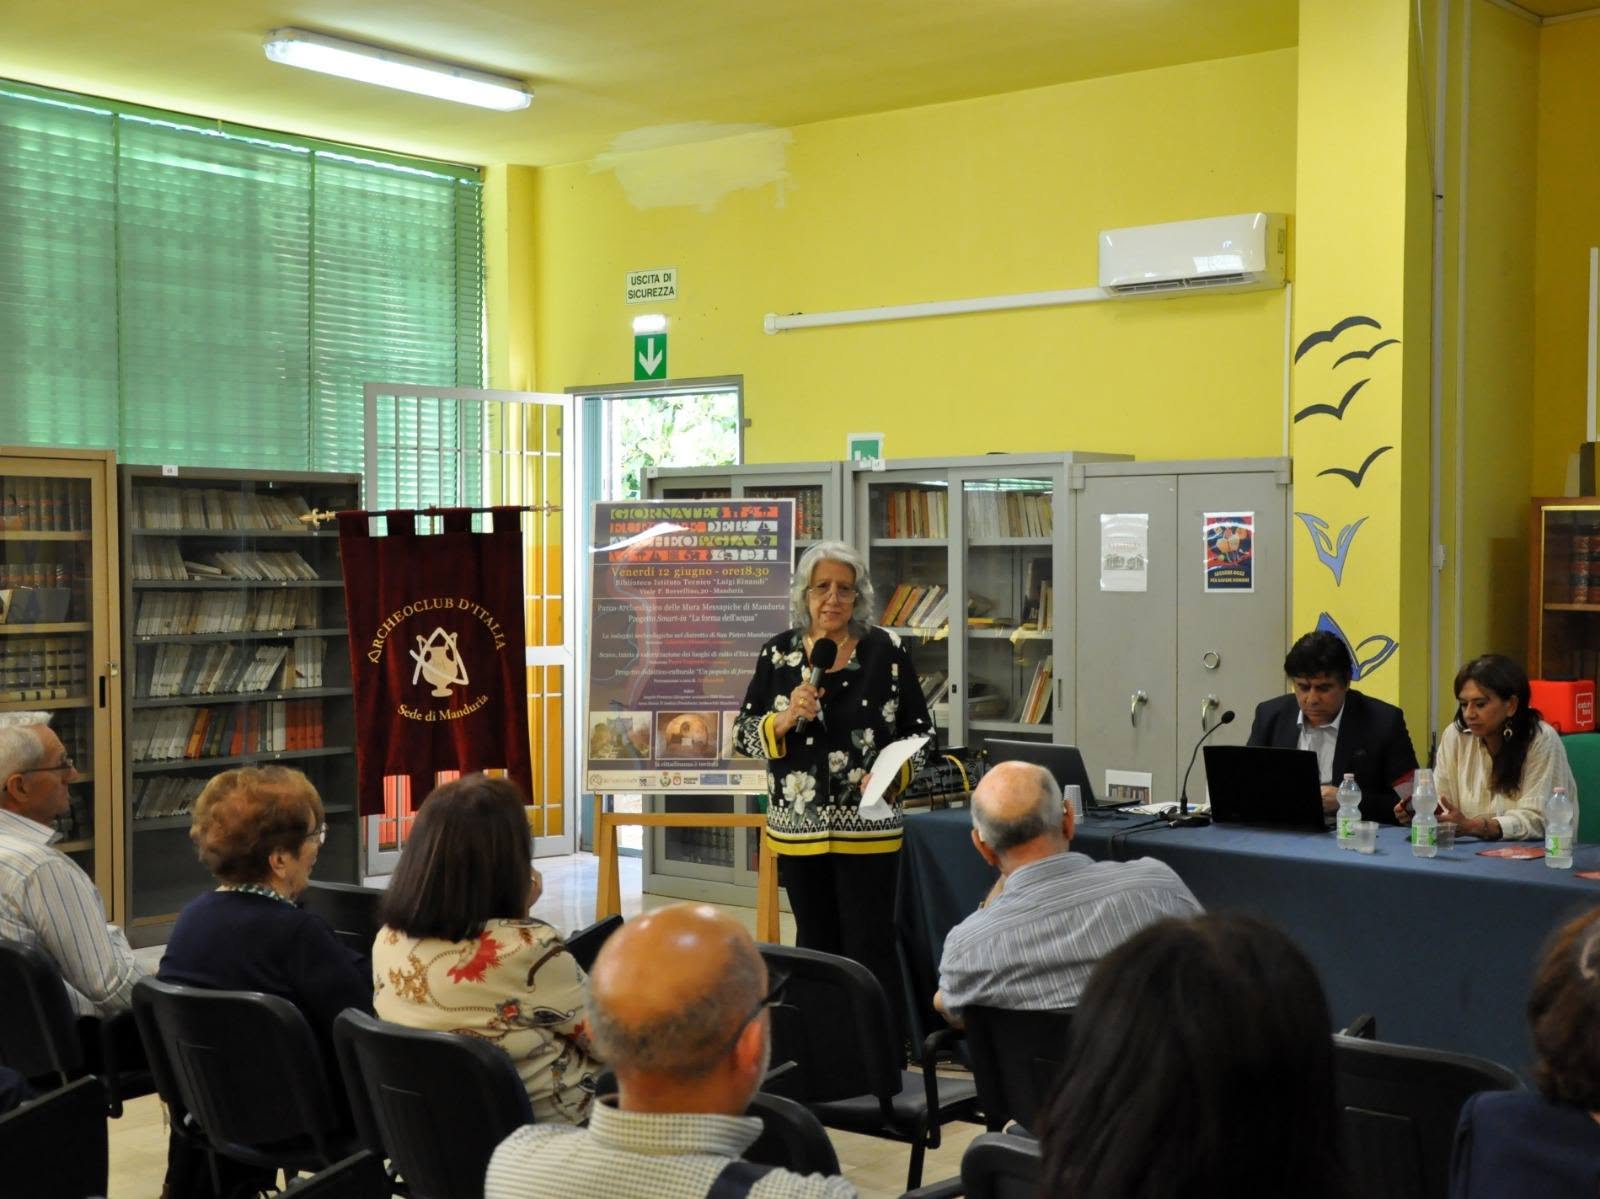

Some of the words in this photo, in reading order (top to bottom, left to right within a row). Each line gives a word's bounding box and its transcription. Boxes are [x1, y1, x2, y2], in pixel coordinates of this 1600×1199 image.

[631, 274, 660, 286] USCITA
[663, 272, 672, 283] DI
[627, 286, 675, 300] SICUREZZA
[659, 567, 670, 577] 12
[674, 566, 713, 579] giugno
[743, 602, 750, 611] di
[752, 602, 785, 611] Manduria
[367, 597, 454, 664] ARCHEOCLUB
[458, 597, 506, 651] D'ITALIA
[397, 704, 422, 721] Sede
[425, 710, 437, 722] di
[439, 694, 488, 721] Manduria
